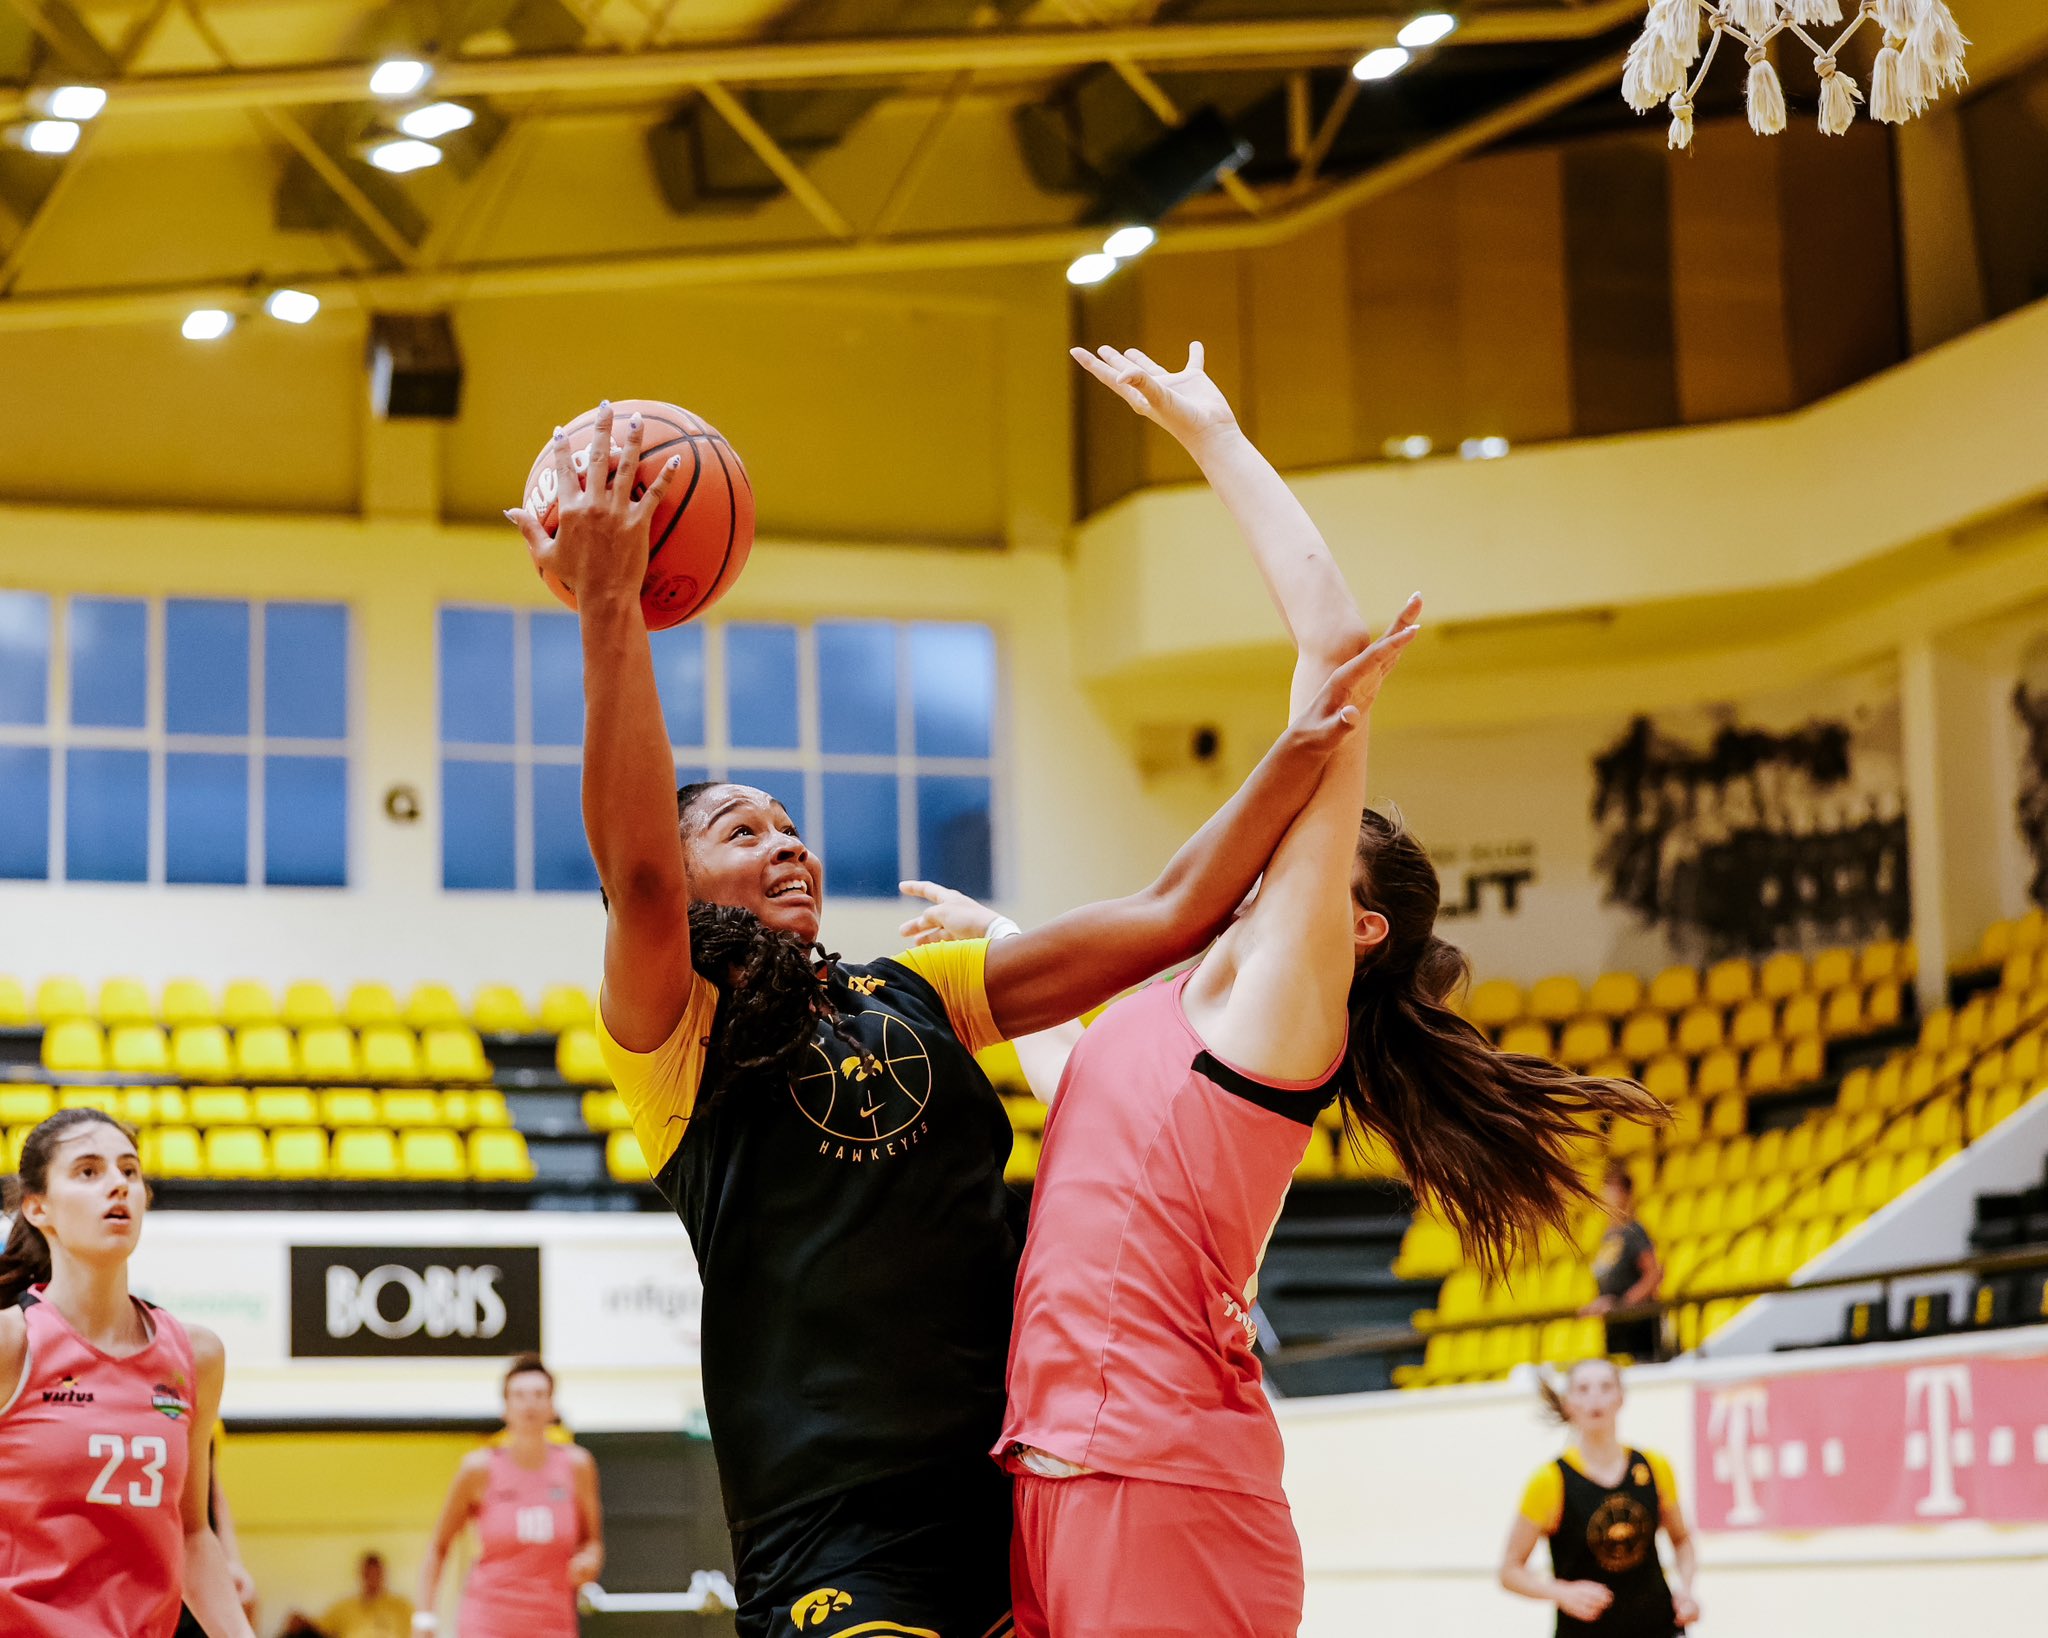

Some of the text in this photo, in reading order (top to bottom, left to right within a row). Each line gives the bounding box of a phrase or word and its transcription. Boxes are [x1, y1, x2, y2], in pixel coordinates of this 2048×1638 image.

[818, 1121, 929, 1162] HAWKEYES
[326, 1263, 507, 1339] BOBIS
[86, 1433, 167, 1508] 23
